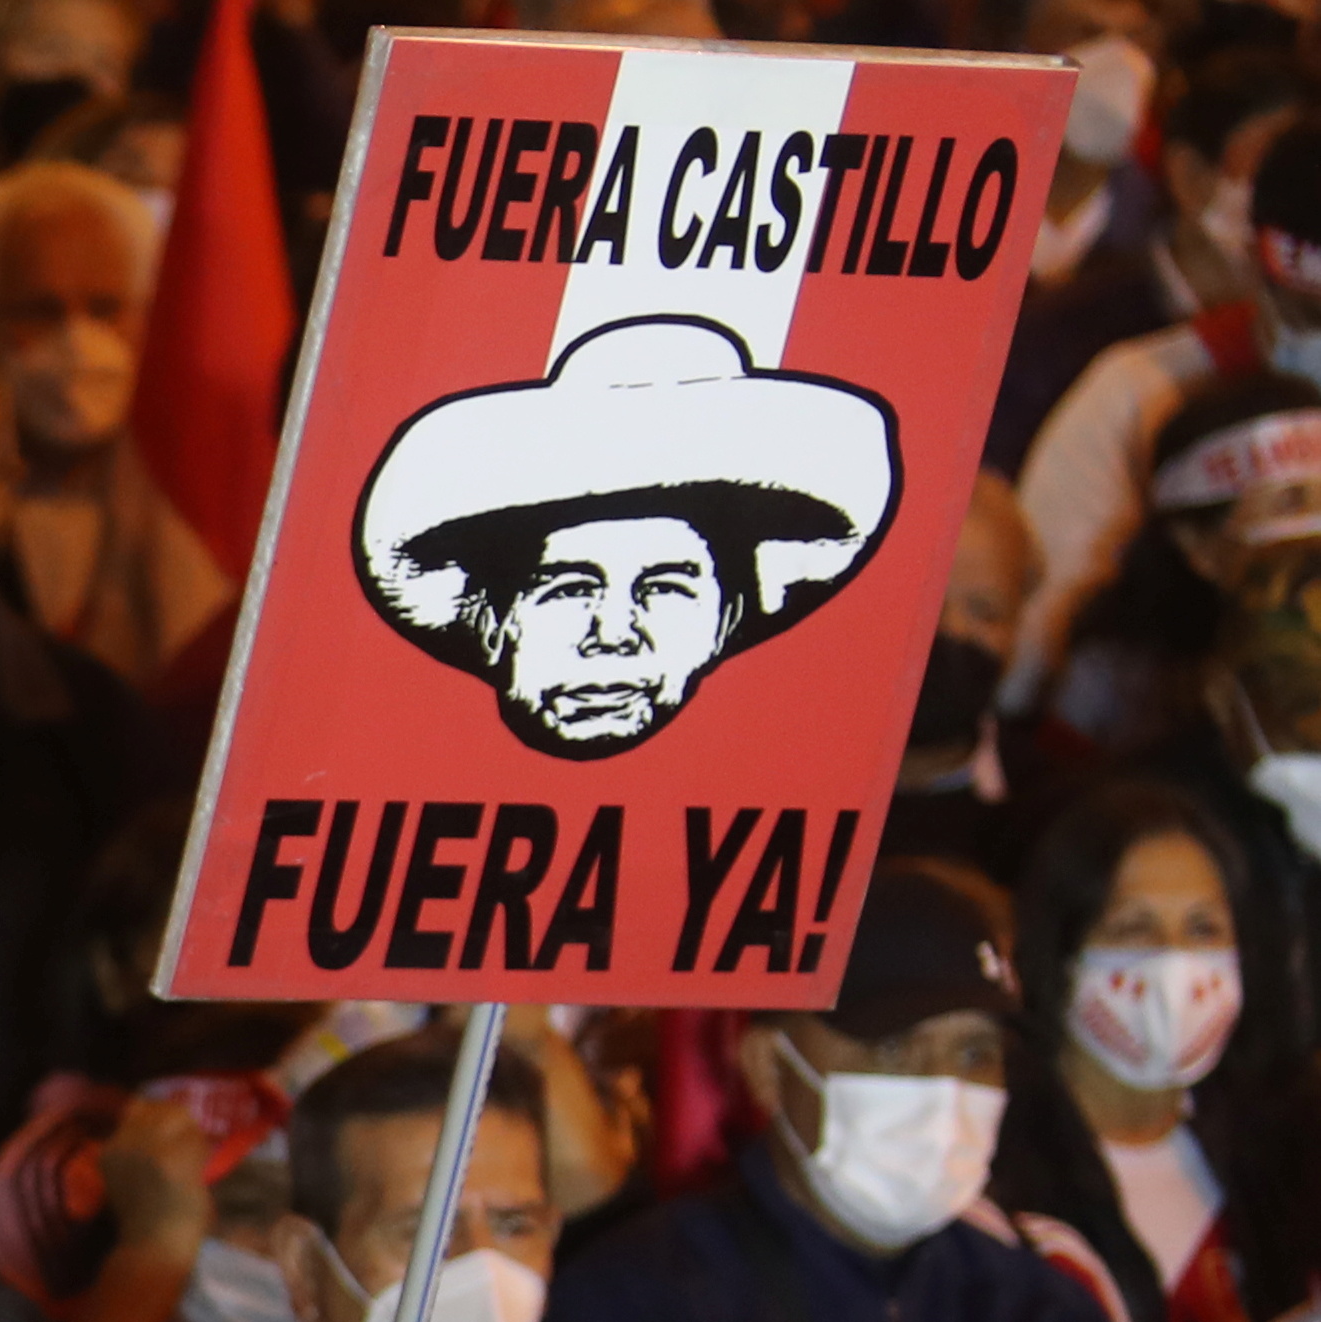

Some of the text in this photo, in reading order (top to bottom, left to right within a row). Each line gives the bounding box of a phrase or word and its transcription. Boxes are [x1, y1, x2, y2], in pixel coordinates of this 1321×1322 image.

[384, 116, 1017, 280] FUERA CASTILLO
[228, 800, 859, 973] FUERA YA!
